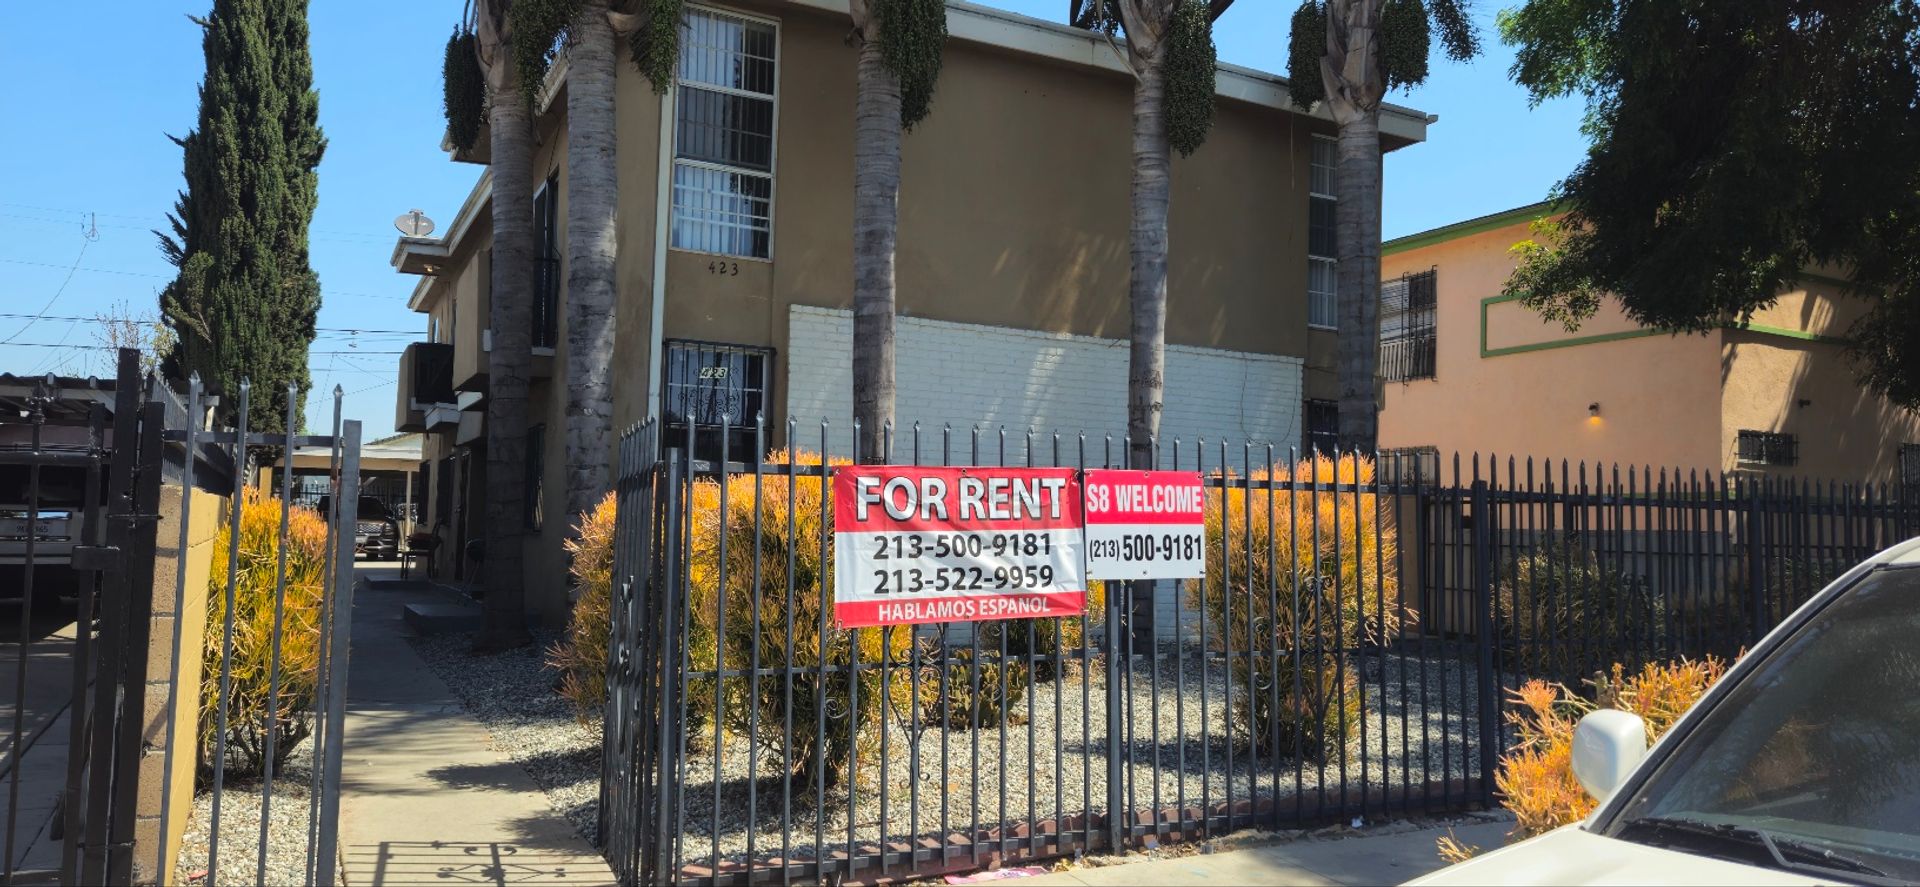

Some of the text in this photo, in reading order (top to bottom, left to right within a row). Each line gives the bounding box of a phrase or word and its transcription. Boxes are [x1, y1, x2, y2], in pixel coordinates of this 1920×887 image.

[708, 261, 738, 276] 423
[701, 368, 726, 378] 423
[856, 476, 1066, 522] FOR RENT
[1087, 484, 1202, 513] S8 WELCOME
[873, 532, 1051, 561] 213-500-9181
[1089, 533, 1202, 563] (213) 500-9181
[873, 564, 1054, 594] 213-522-9959
[878, 597, 1051, 621] HABLAMOS ESPANOL
